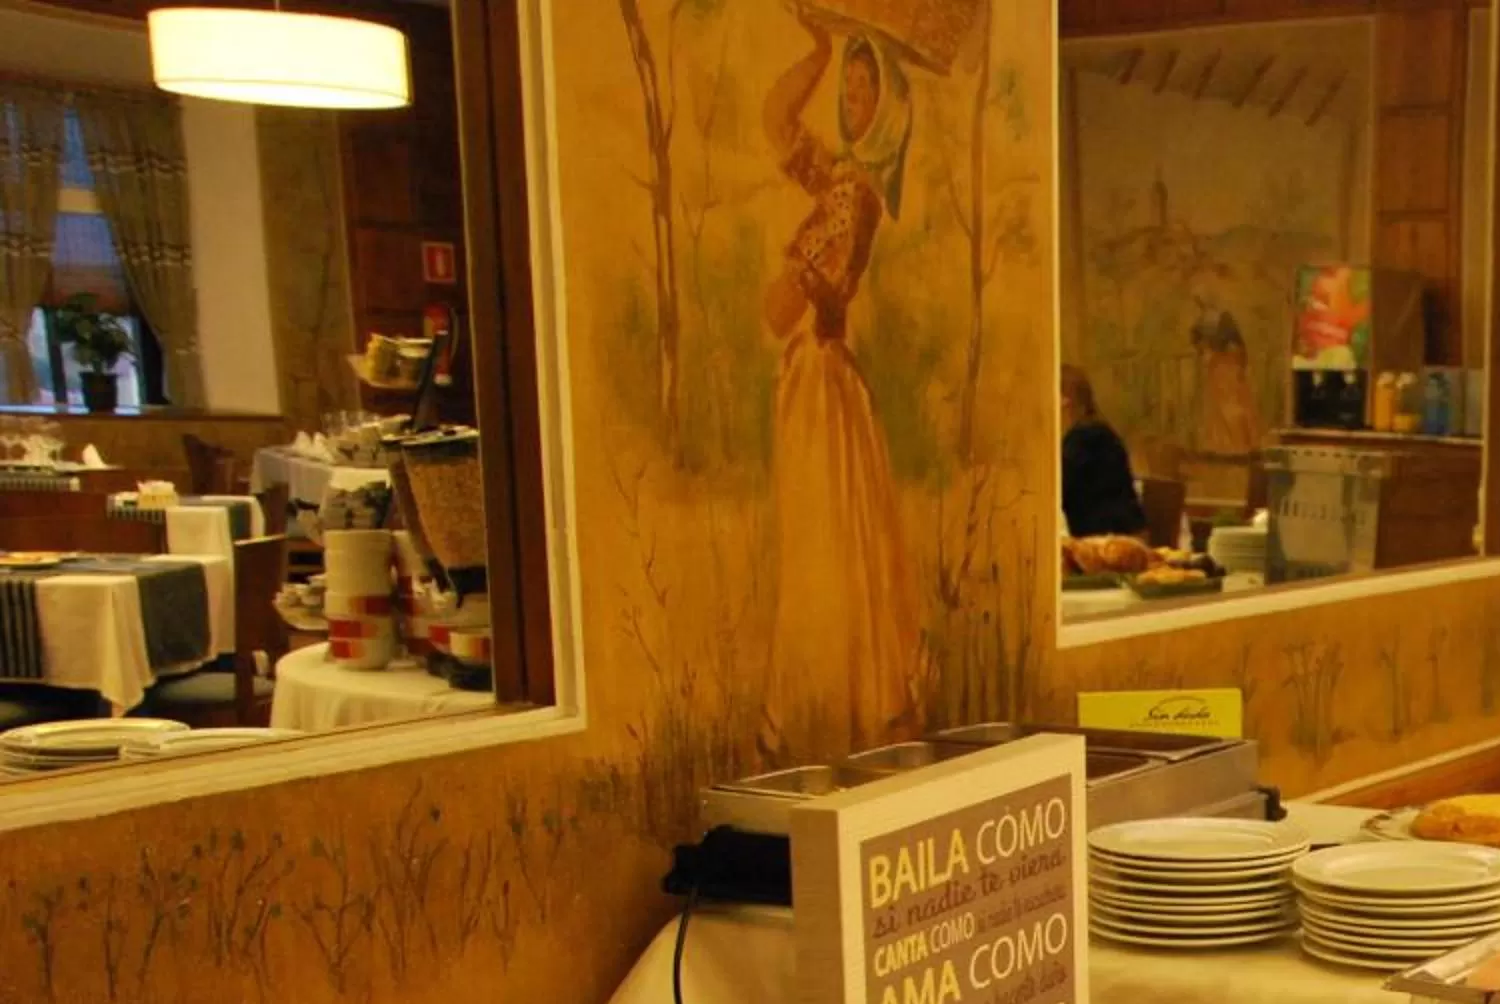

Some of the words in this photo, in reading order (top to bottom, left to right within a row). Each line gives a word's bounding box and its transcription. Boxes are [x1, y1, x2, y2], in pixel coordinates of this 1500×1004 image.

[869, 828, 969, 909] BAILA
[976, 797, 1065, 865] COMO
[907, 879, 976, 926] nadie
[874, 931, 928, 977] CANTA
[930, 912, 975, 953] COMO
[969, 913, 1067, 989] COMO
